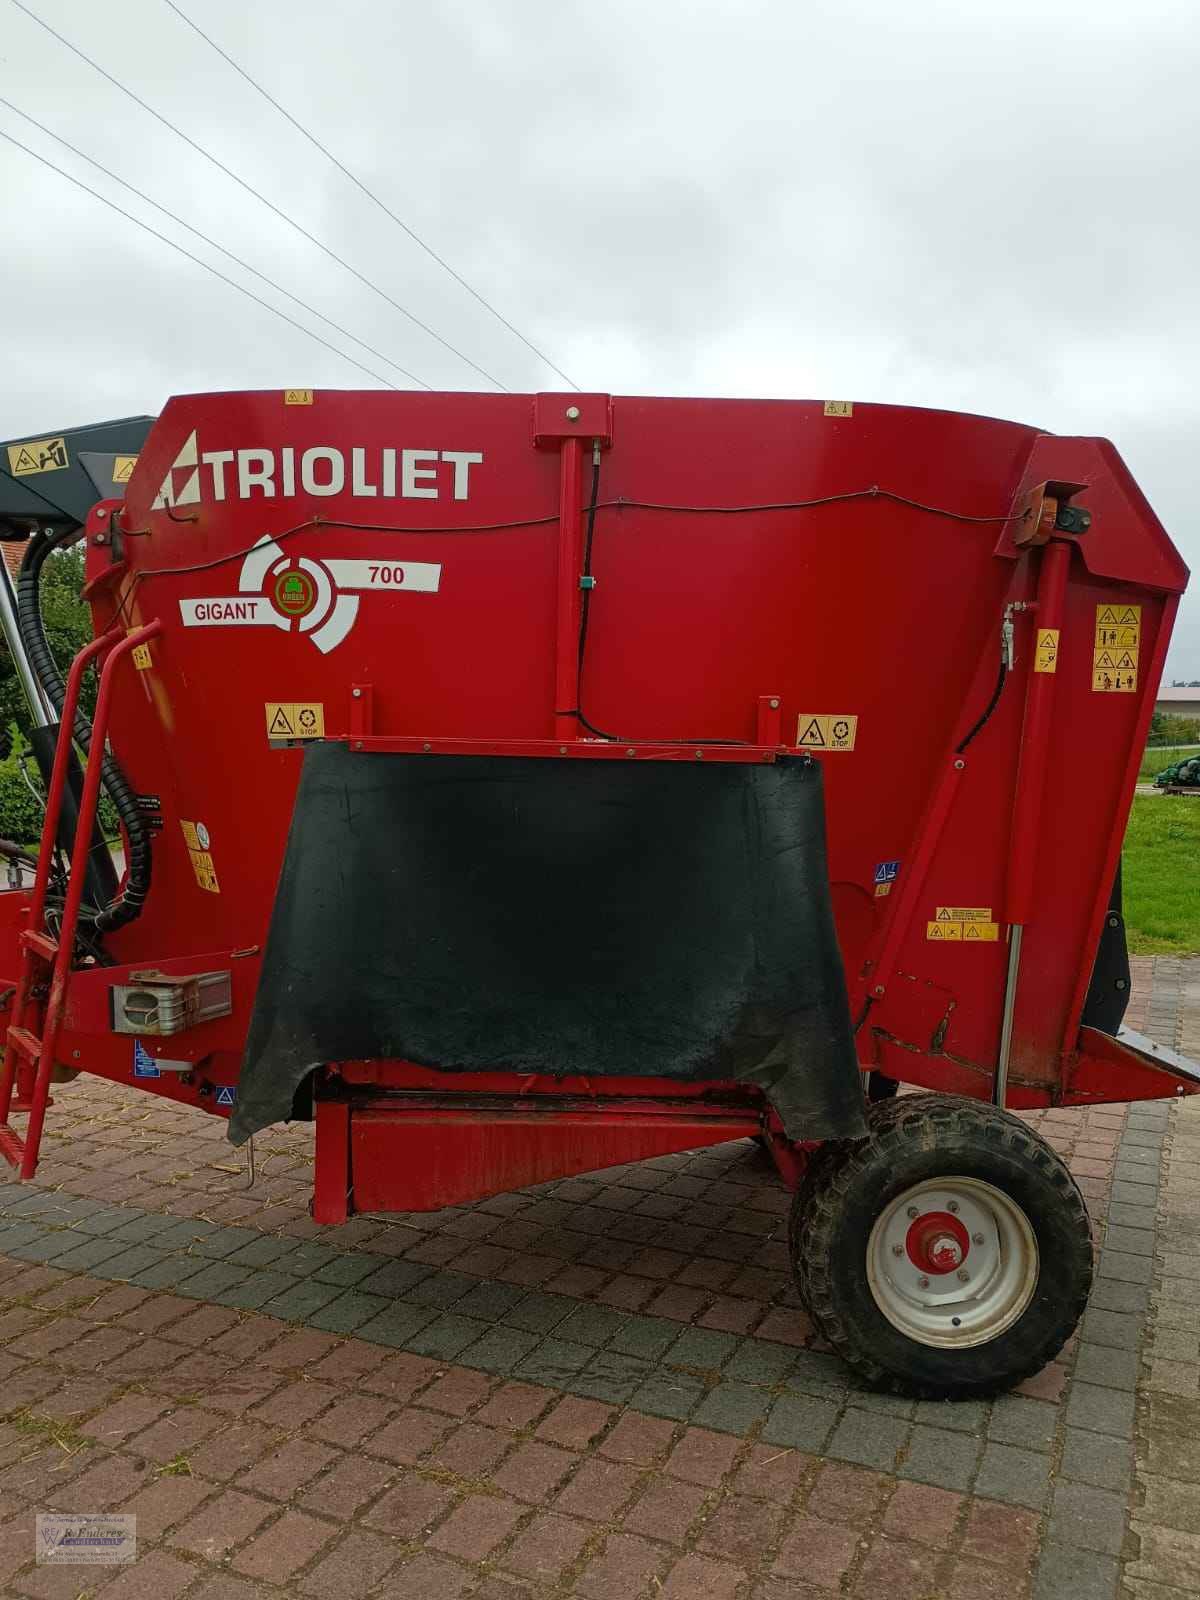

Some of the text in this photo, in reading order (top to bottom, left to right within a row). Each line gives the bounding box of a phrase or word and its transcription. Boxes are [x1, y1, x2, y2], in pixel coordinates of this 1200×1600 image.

[202, 447, 483, 500] TRIOLIET
[368, 566, 405, 584] 700
[194, 602, 258, 621] GIGANT
[300, 728, 318, 736] STOP
